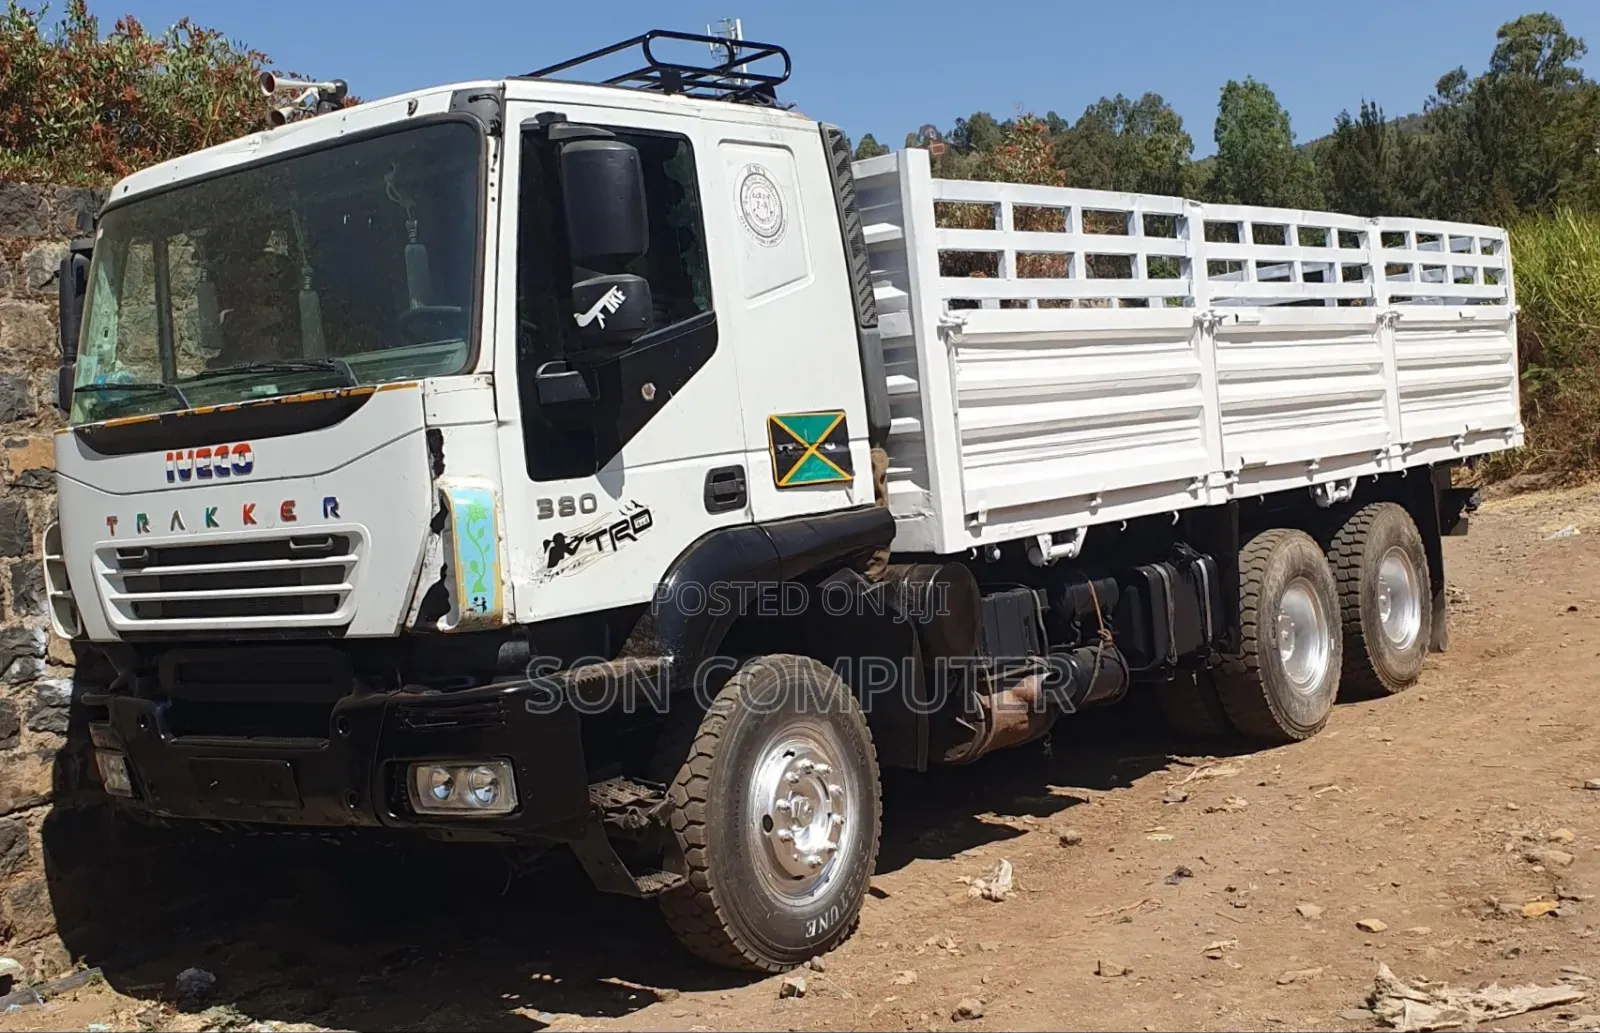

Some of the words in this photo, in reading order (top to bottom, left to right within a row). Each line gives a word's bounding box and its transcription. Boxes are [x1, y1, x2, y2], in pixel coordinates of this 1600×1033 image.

[165, 442, 254, 484] IVECO
[106, 496, 341, 537] TRAKKER
[536, 493, 598, 520] 380
